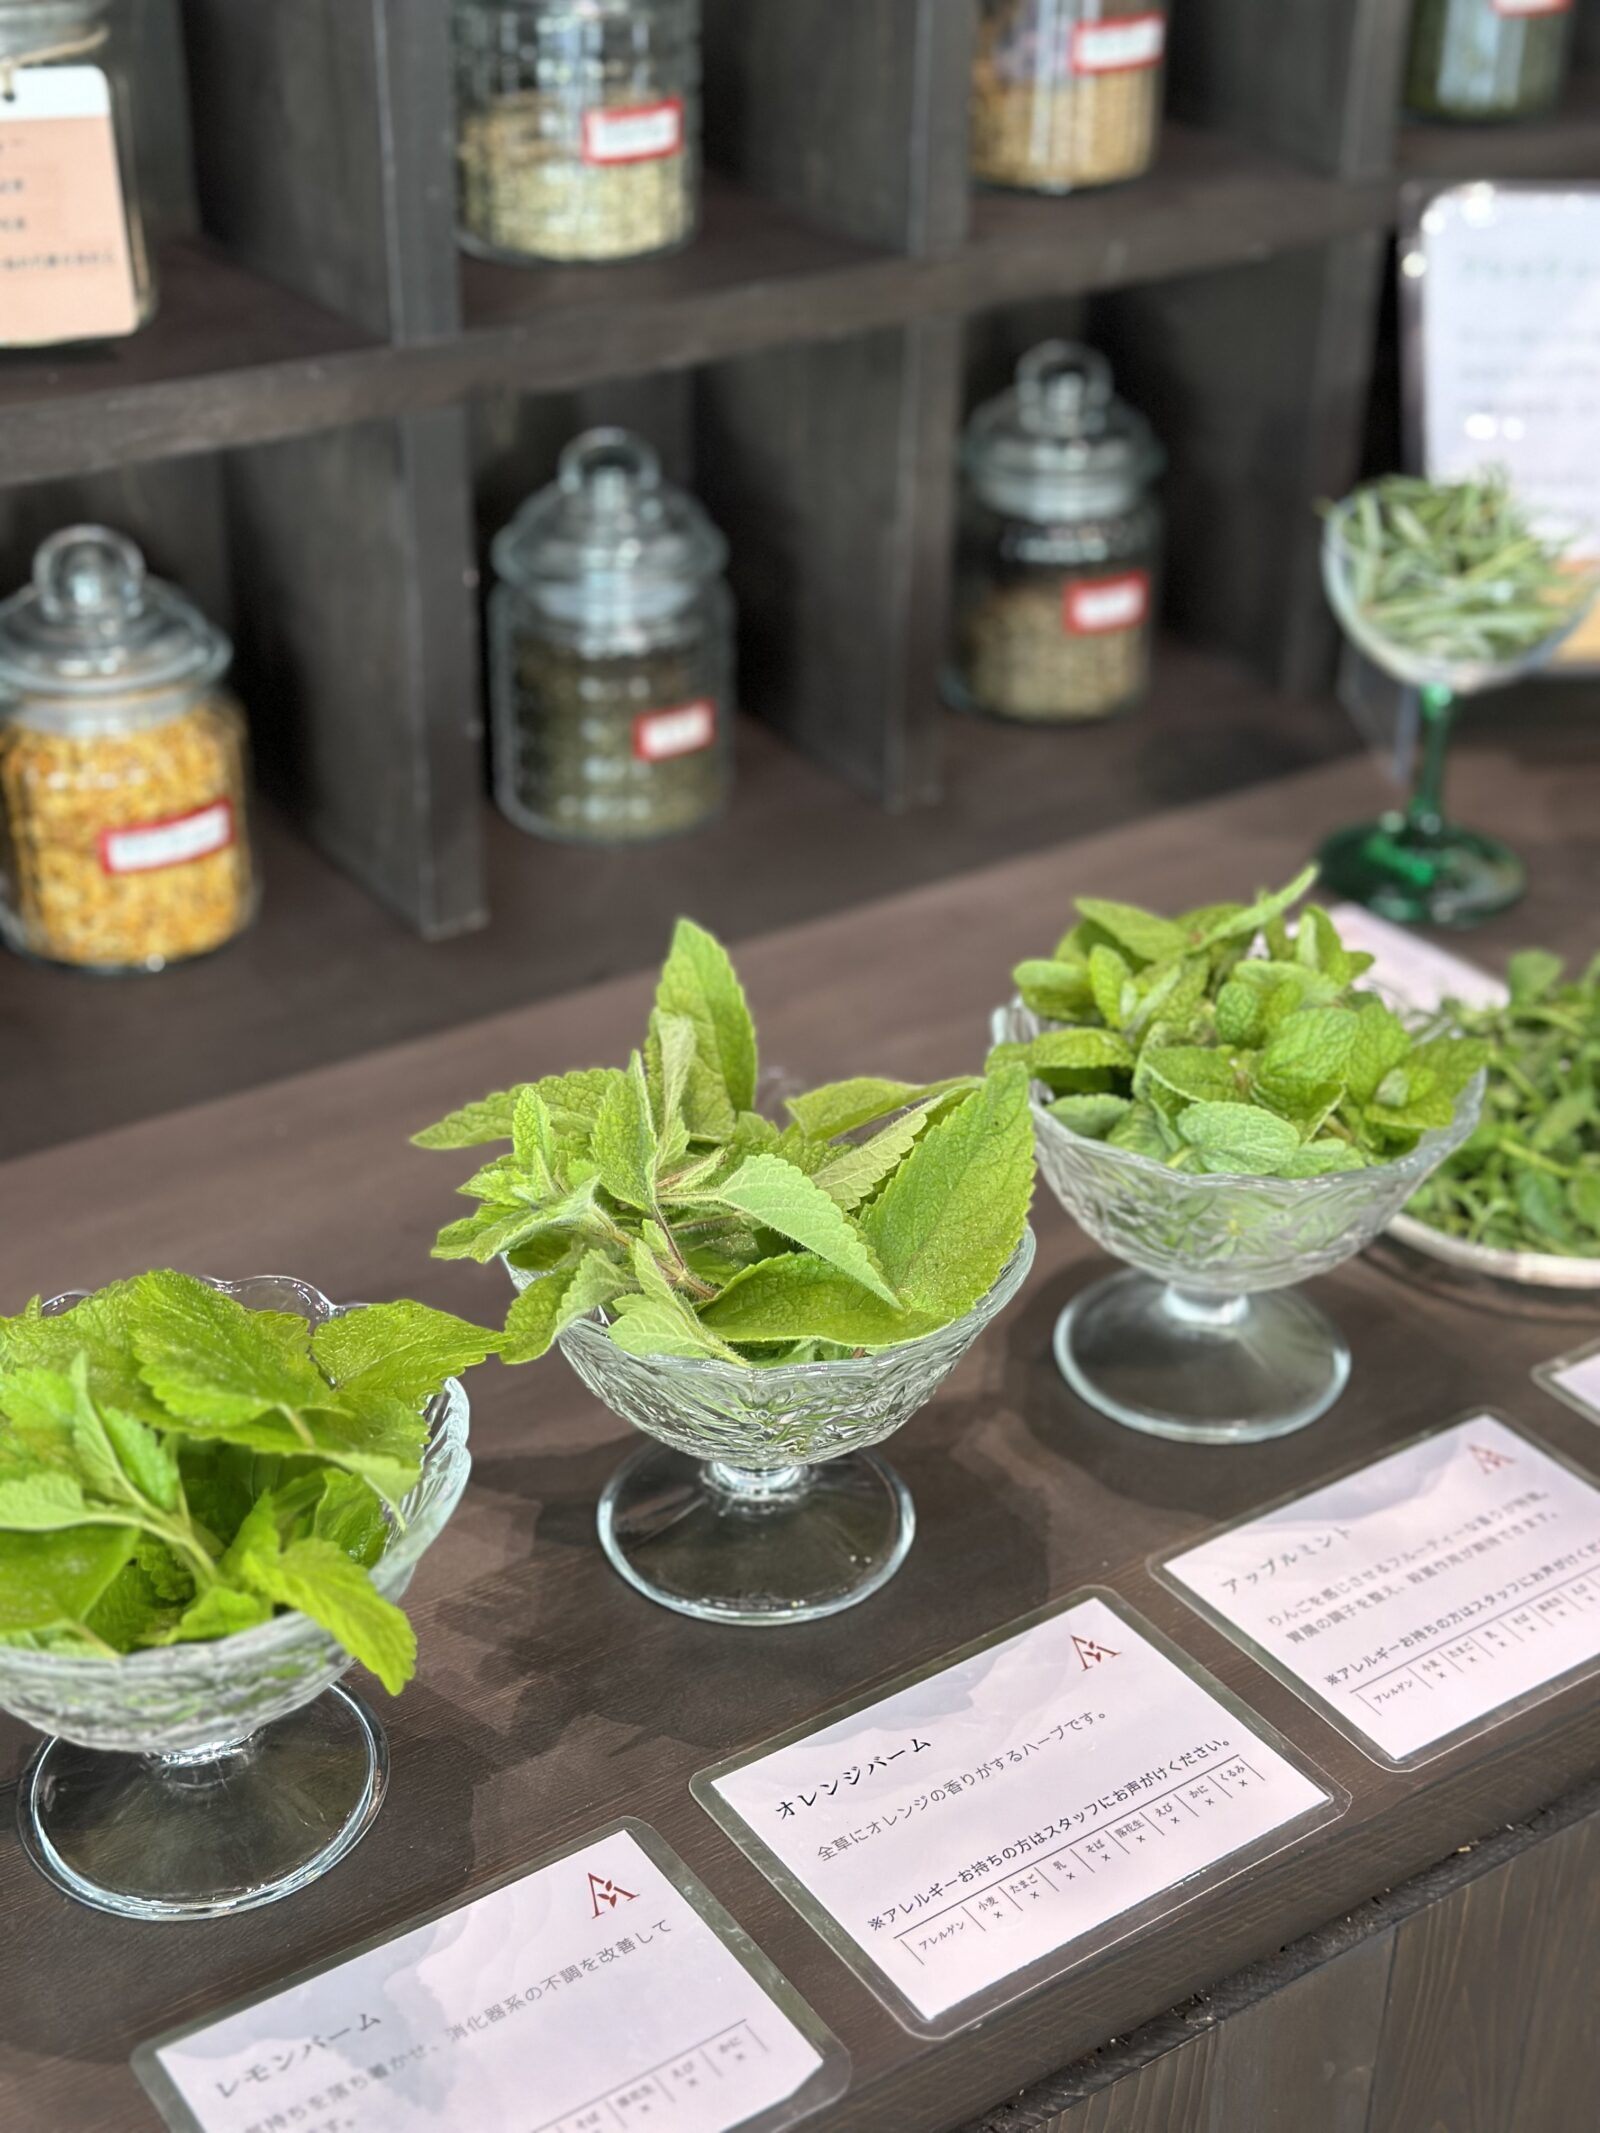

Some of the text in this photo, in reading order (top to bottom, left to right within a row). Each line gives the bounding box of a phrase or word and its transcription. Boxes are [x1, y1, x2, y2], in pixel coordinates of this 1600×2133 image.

[1220, 1525, 1352, 1594] アップルミント
[775, 1738, 932, 1820] オレンジバーム
[817, 1710, 1106, 1861] 全草にオレンジの香りがするハーブです。
[868, 1740, 1230, 1931] ※アレルギーお持ちの方はスタッフにお声がけください。
[919, 1764, 1246, 1950] アレルゲン 小麦 たまご 乳 そば 落花生 えび かに くるみ
[216, 2013, 381, 2099] レモンバーム
